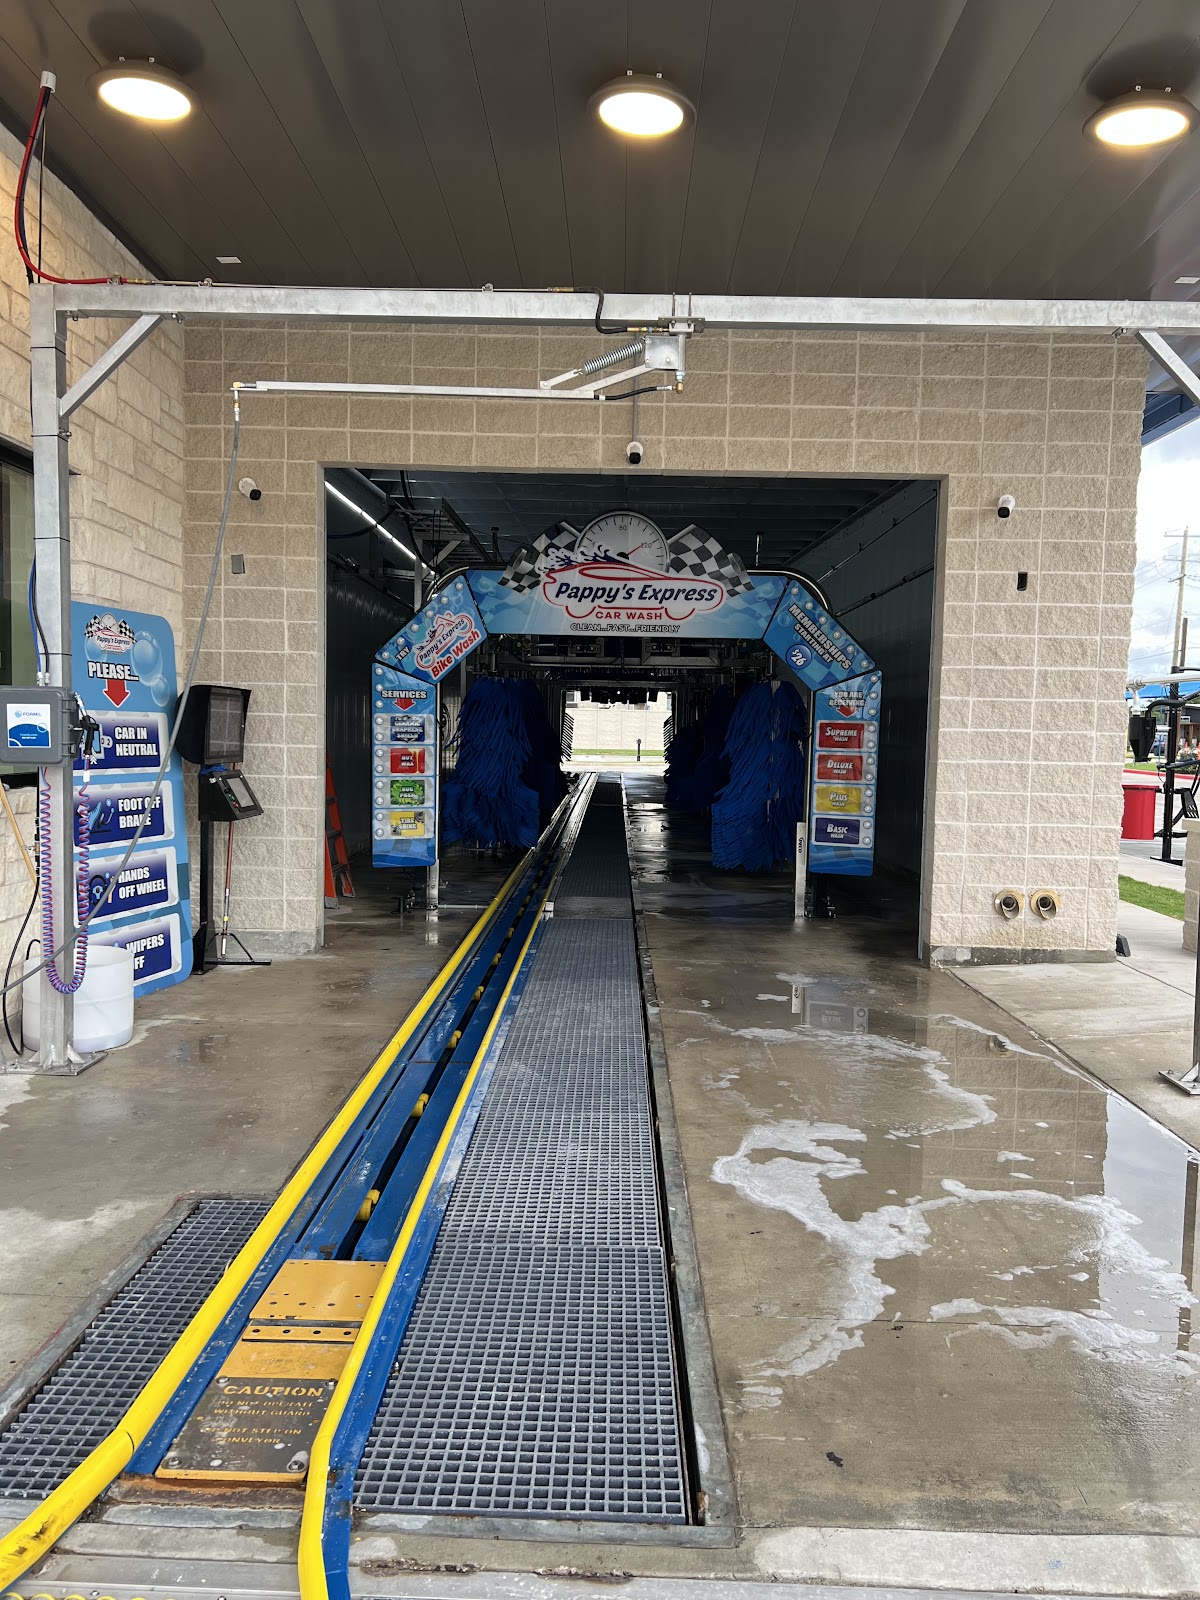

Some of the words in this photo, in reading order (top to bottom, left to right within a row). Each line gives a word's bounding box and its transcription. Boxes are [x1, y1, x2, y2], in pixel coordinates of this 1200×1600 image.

[555, 583, 635, 604] Pappy's
[638, 584, 717, 604] Express
[595, 611, 621, 620] CAR
[626, 612, 662, 620] WASH
[97, 635, 113, 645] Pappy's
[114, 637, 130, 646] Express
[419, 639, 442, 661] Pappy's
[442, 618, 465, 641] Express
[788, 603, 852, 670] MEMBERSHIPS
[794, 623, 824, 656] STARTING
[822, 653, 834, 663] AT
[395, 646, 411, 661] TRY
[431, 655, 453, 678] Bike
[452, 630, 480, 657] Wash
[791, 649, 807, 666] $26
[88, 661, 139, 681] PLEASE...
[382, 690, 427, 699] SERVICES
[114, 726, 135, 740] CAR
[137, 727, 148, 740] IN
[825, 727, 858, 736] SUPREME
[115, 744, 158, 757] NEUTRAL
[827, 759, 853, 769] DELUXE
[829, 791, 848, 801] PLUS
[118, 798, 143, 812] FOOT
[827, 823, 848, 834] BASIC
[118, 866, 150, 884] HANDS
[119, 884, 136, 899] OFF
[136, 879, 167, 895] WHEEL
[126, 933, 165, 954] WIPERS
[134, 955, 145, 970] FF
[223, 1385, 324, 1397] CAUTION
[251, 1427, 281, 1435] STEP
